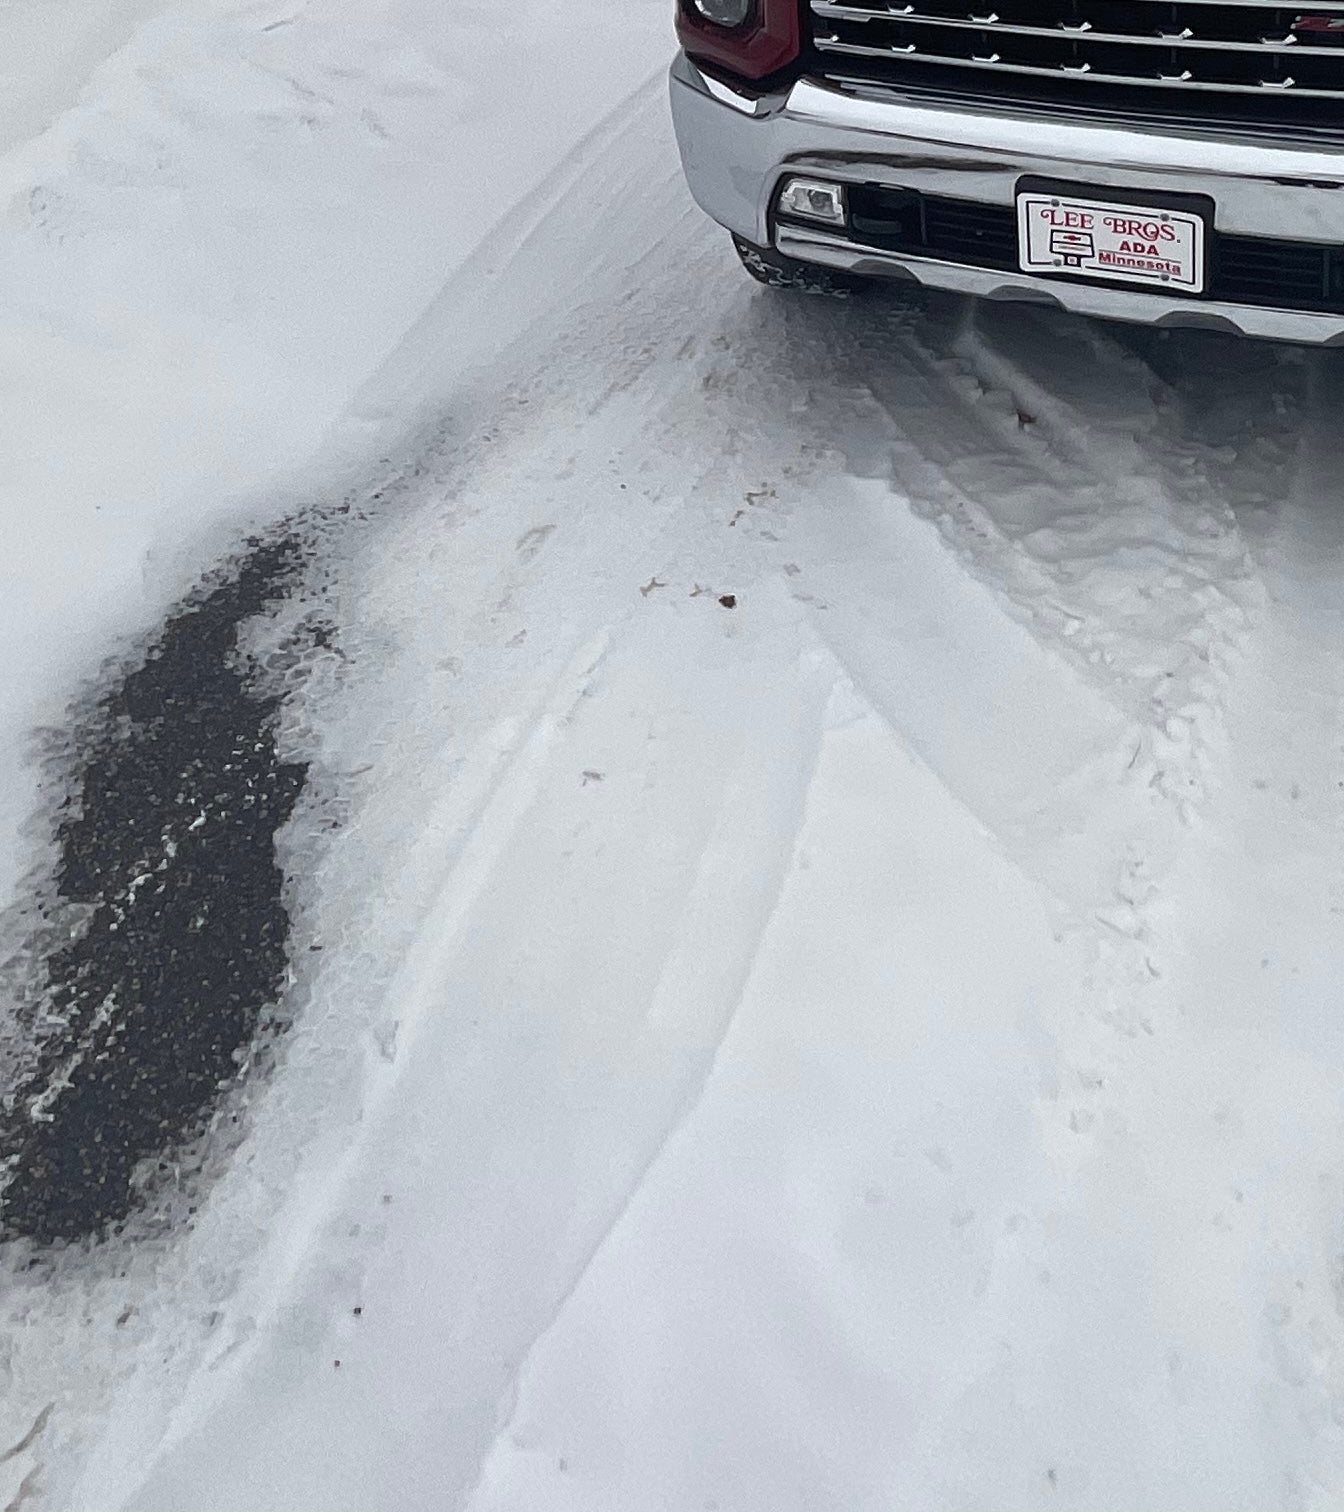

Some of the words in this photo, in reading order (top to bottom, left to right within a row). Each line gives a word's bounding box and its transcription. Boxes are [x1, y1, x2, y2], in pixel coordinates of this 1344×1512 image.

[1040, 208, 1094, 230] LEE
[1119, 240, 1160, 256] ADA
[1098, 251, 1182, 276] Minnesota
